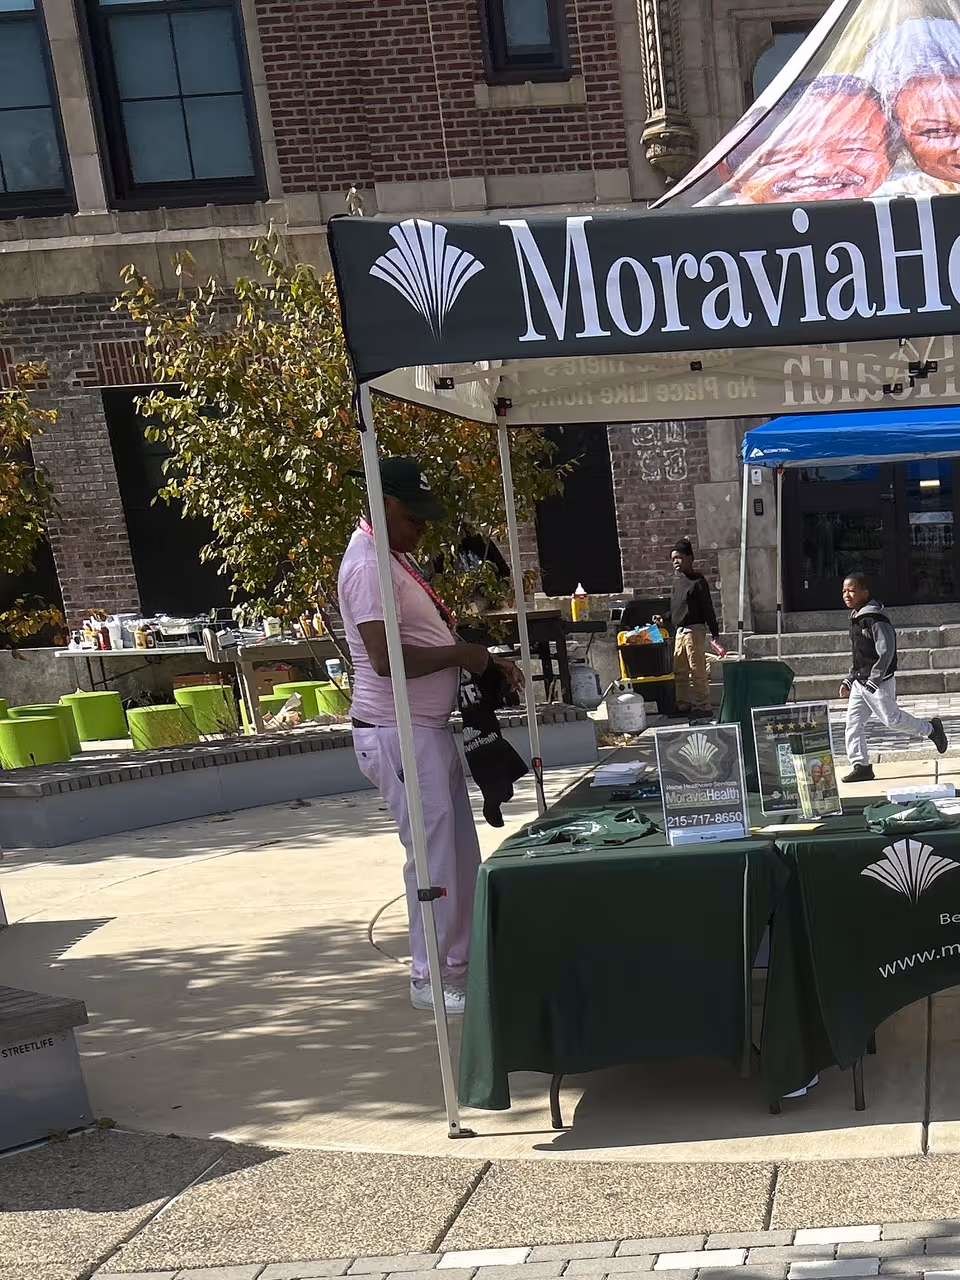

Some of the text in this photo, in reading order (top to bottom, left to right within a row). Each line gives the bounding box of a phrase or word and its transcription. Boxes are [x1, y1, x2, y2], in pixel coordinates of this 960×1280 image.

[665, 788, 740, 804] MoraviaHealth
[668, 811, 743, 827] 215-717-8650
[1, 1037, 54, 1058] STREETLIFE
